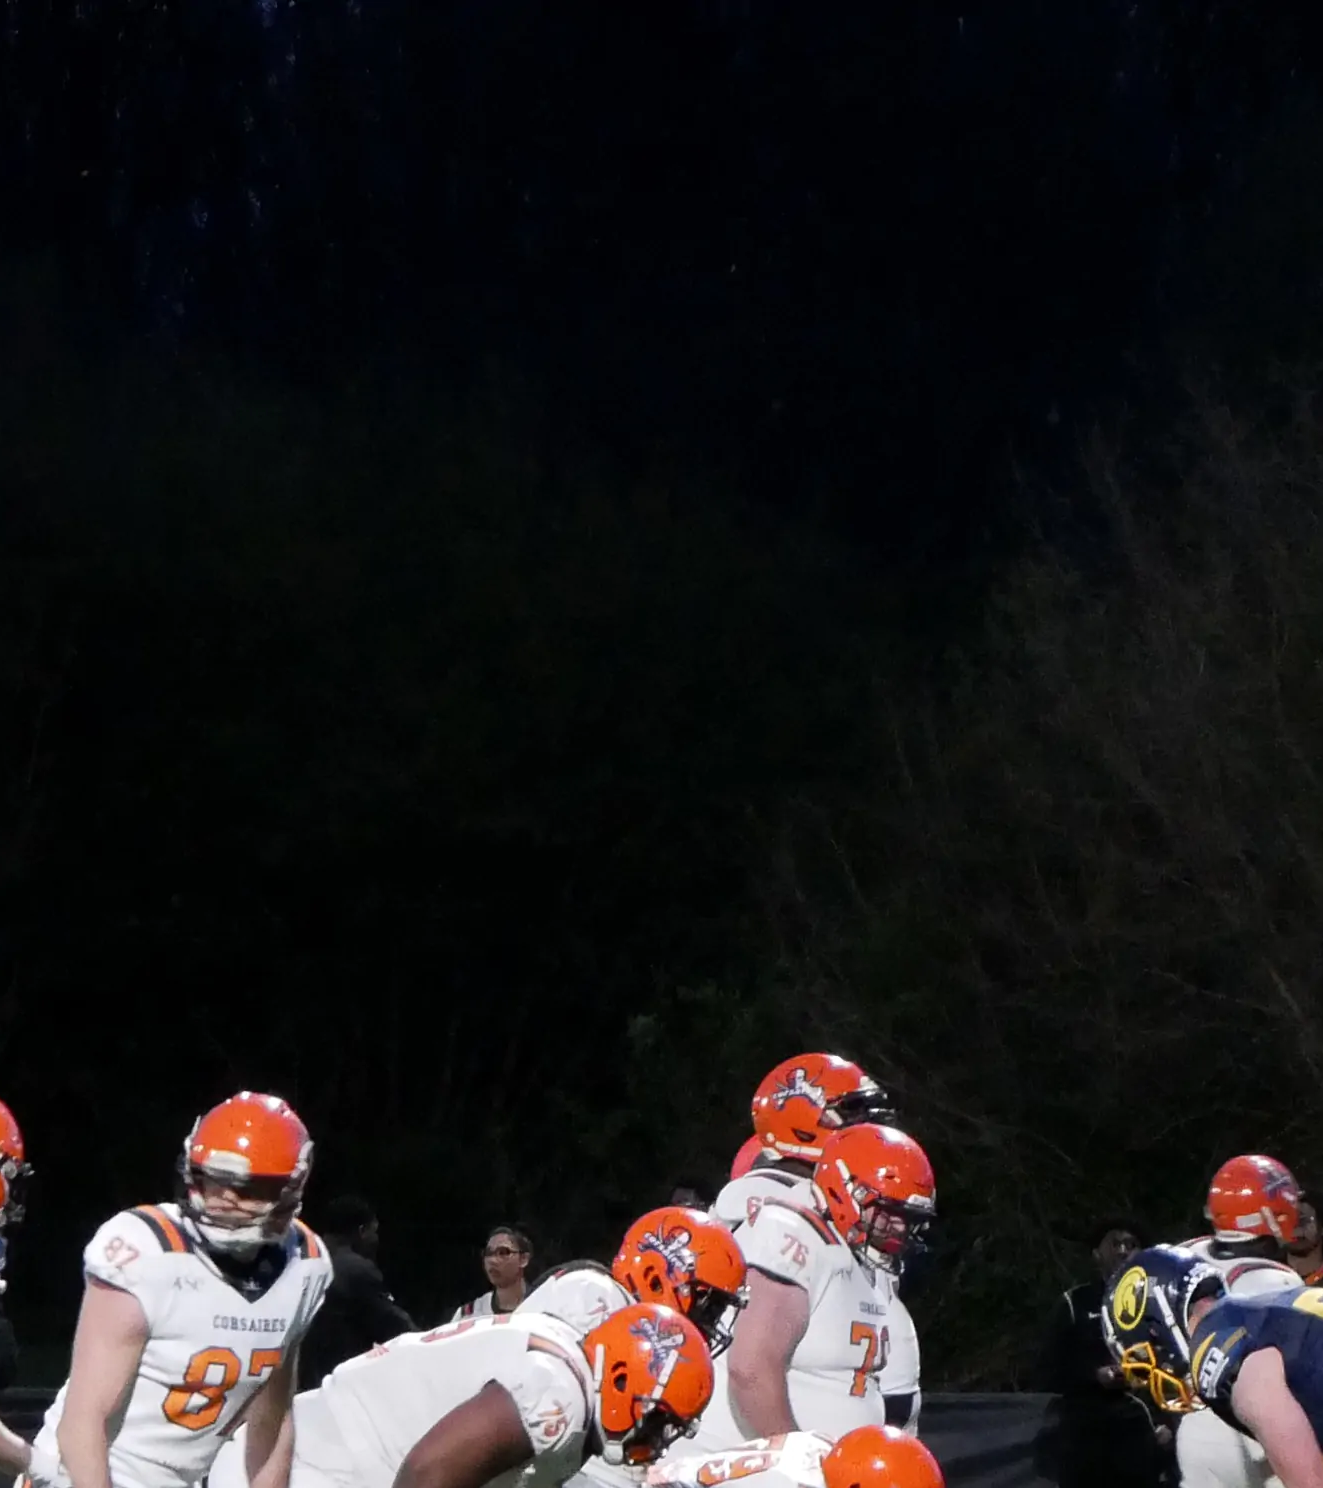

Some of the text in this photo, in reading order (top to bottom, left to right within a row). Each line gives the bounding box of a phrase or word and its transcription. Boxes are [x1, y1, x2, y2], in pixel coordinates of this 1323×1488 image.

[104, 1236, 141, 1267] 87
[779, 1233, 810, 1269] 76
[213, 1314, 287, 1333] CORSAIRES
